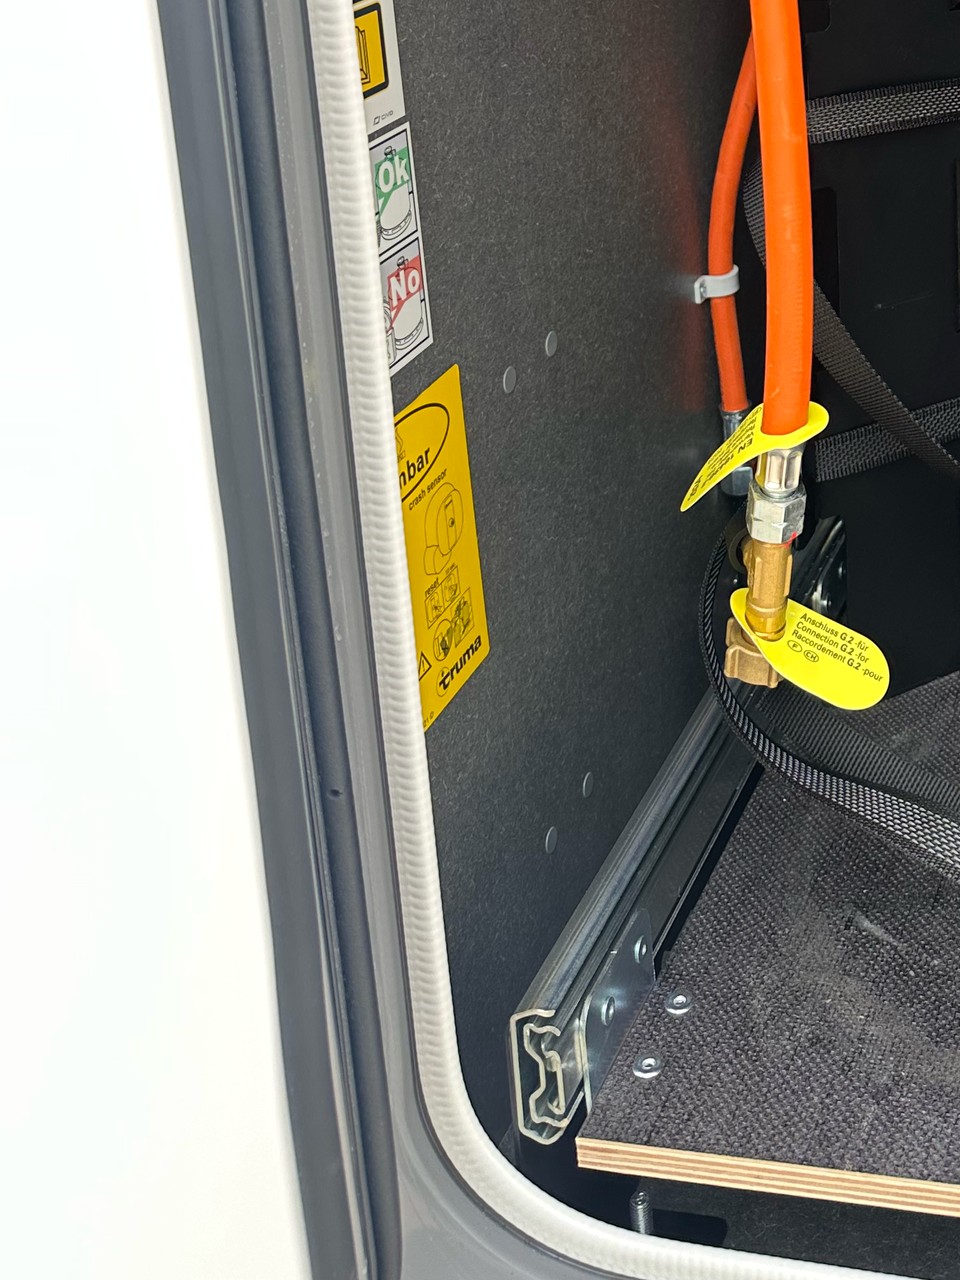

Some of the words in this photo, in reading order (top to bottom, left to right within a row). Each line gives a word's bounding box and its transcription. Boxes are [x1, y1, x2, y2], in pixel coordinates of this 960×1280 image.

[378, 154, 410, 193] Ok
[390, 269, 420, 307] No
[408, 489, 426, 511] crash
[426, 468, 447, 494] sensor
[424, 577, 440, 597] reset
[796, 621, 839, 648] Connection
[840, 644, 854, 656] G.2
[855, 652, 869, 663] -for
[800, 613, 839, 637] Anschluss
[840, 632, 854, 644] G.2
[855, 640, 869, 652] -für
[438, 634, 482, 690] truma
[792, 629, 846, 663] Raccordement
[847, 659, 861, 671] G.2
[862, 668, 883, 682] -pour
